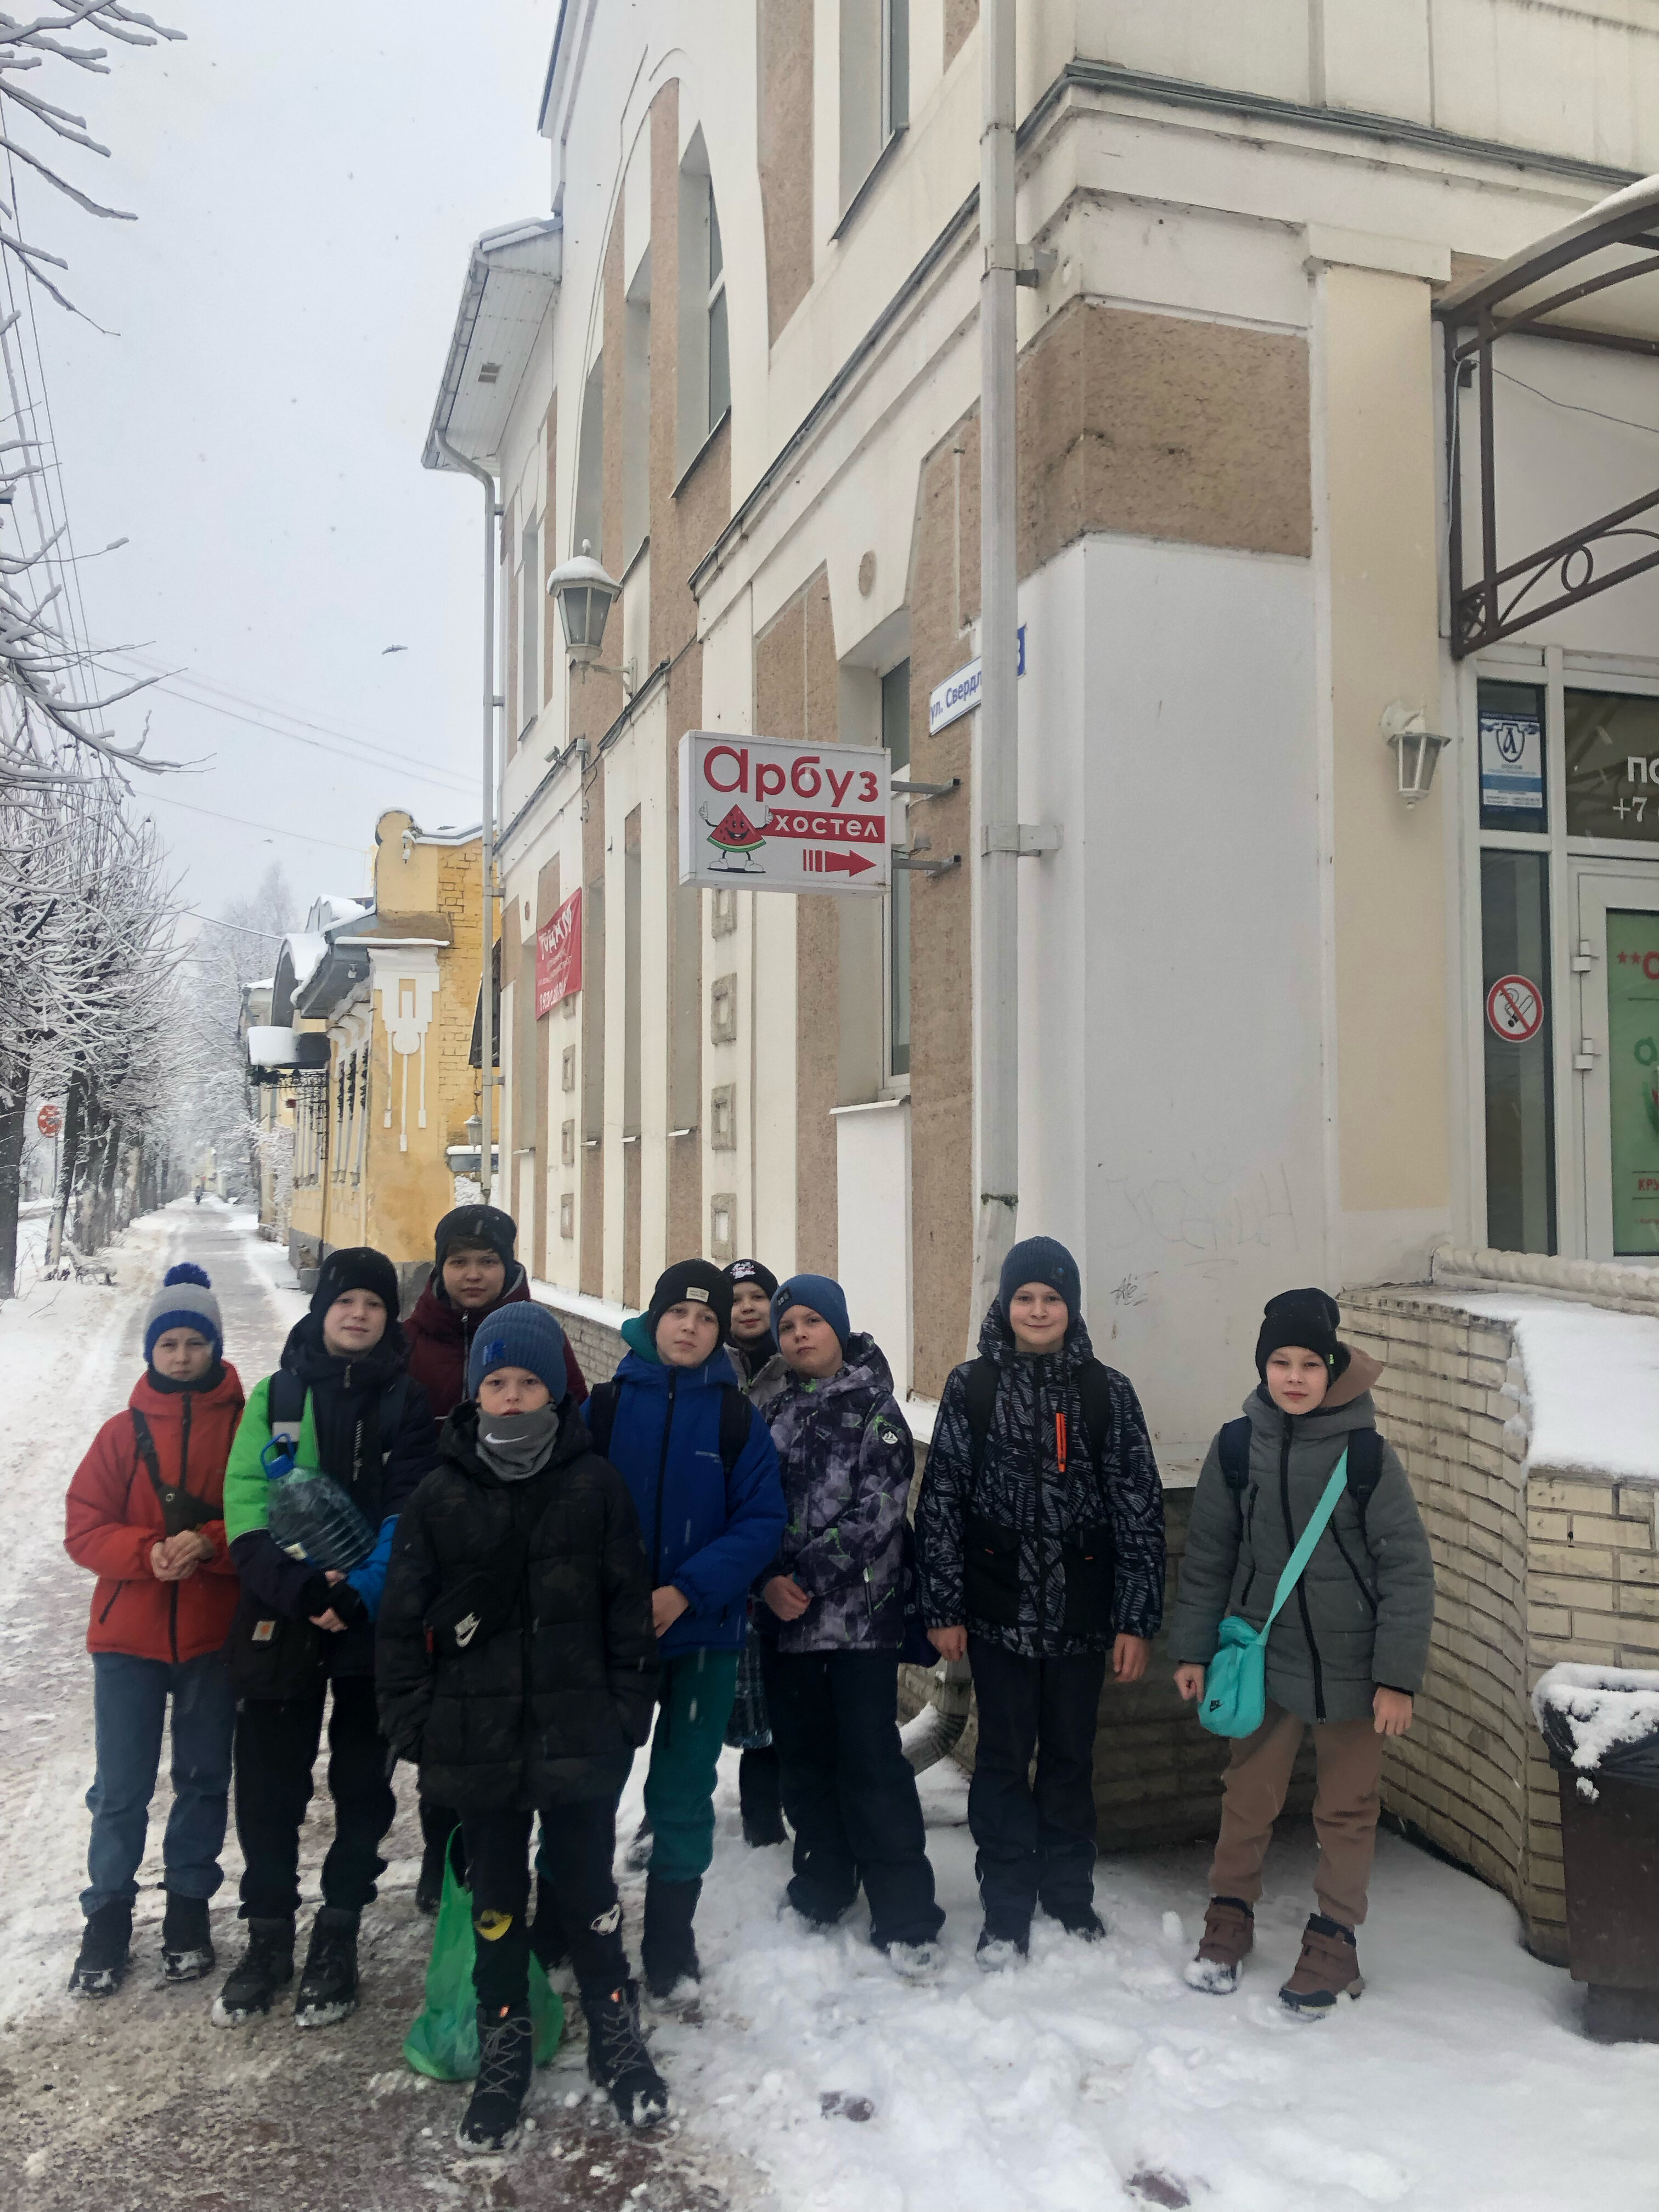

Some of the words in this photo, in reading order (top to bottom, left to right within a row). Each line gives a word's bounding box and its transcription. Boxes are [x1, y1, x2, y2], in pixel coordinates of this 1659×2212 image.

[930, 701, 943, 724] ул.
[1613, 797, 1647, 822] +7
[775, 815, 878, 837] хостел
